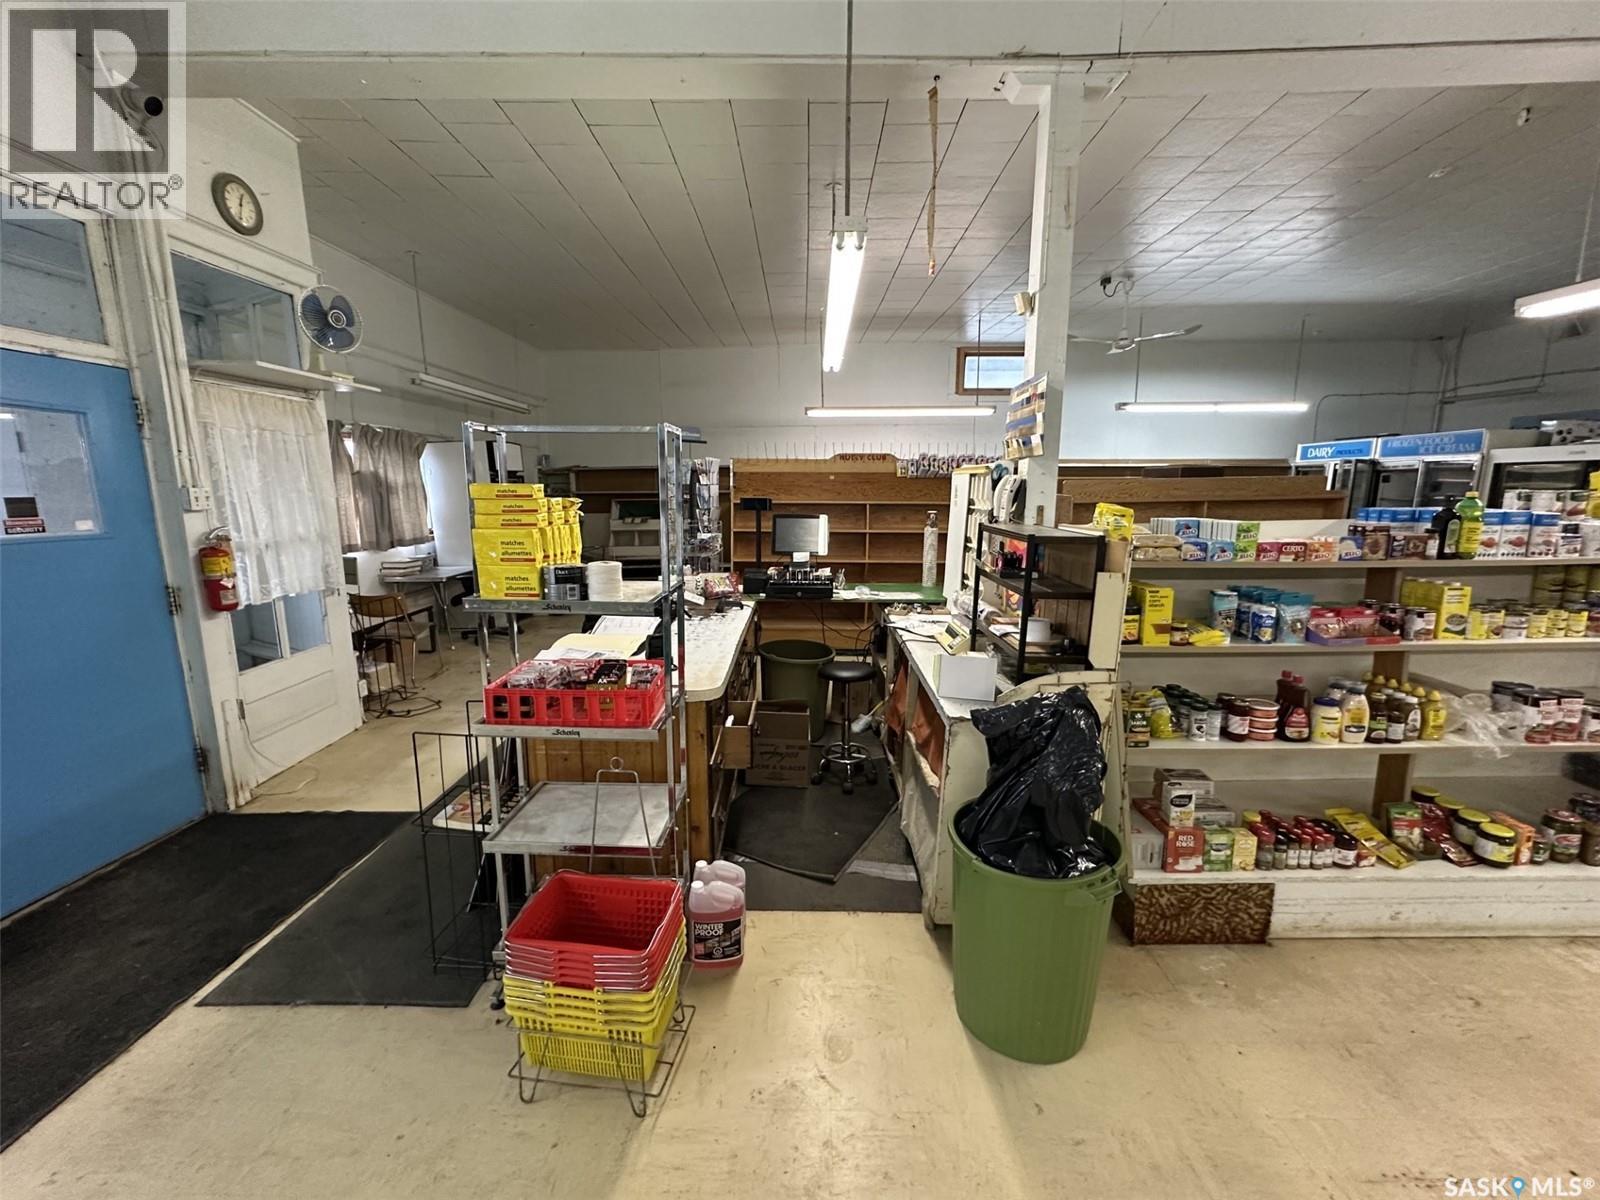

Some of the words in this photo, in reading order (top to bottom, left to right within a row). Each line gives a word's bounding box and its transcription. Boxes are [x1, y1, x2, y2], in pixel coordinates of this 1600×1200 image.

[1307, 446, 1336, 458] DAIRY
[501, 549, 533, 557] allumettes
[505, 584, 537, 592] allumettes
[1178, 834, 1195, 842] RED
[694, 929, 724, 937] PROOF
